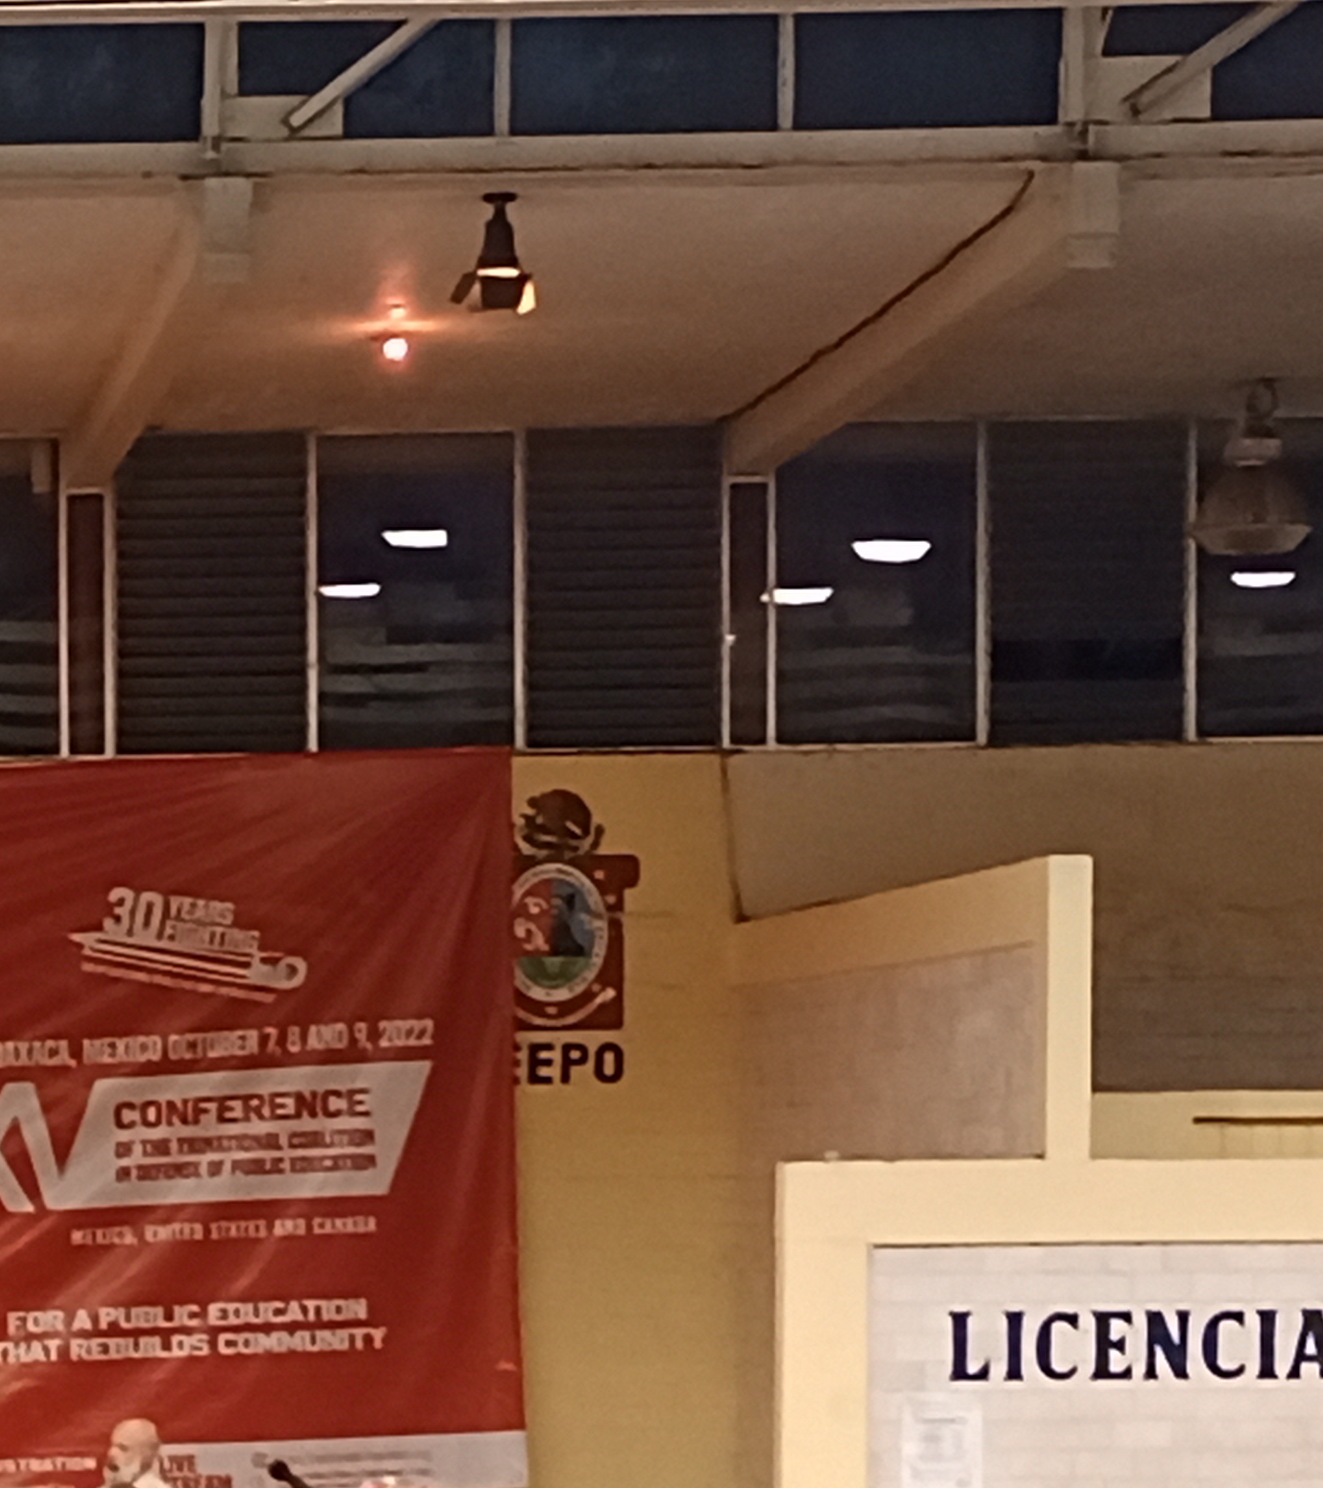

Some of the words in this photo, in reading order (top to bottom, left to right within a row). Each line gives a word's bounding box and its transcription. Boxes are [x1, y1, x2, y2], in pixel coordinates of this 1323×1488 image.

[103, 887, 164, 941] 30
[167, 1030, 259, 1061] OCTOBER
[286, 1025, 302, 1053] 8
[305, 1022, 349, 1051] AND
[377, 1018, 434, 1048] 2022
[515, 1042, 624, 1085] EPO
[113, 1087, 372, 1130] CONFERENCE
[6, 1309, 64, 1336] FOR
[70, 1308, 93, 1333] A
[98, 1304, 202, 1331] PUBLIC
[207, 1298, 368, 1327] EDUCATION
[68, 1333, 211, 1362] REBUILDS
[216, 1327, 388, 1356] COMMUNITY
